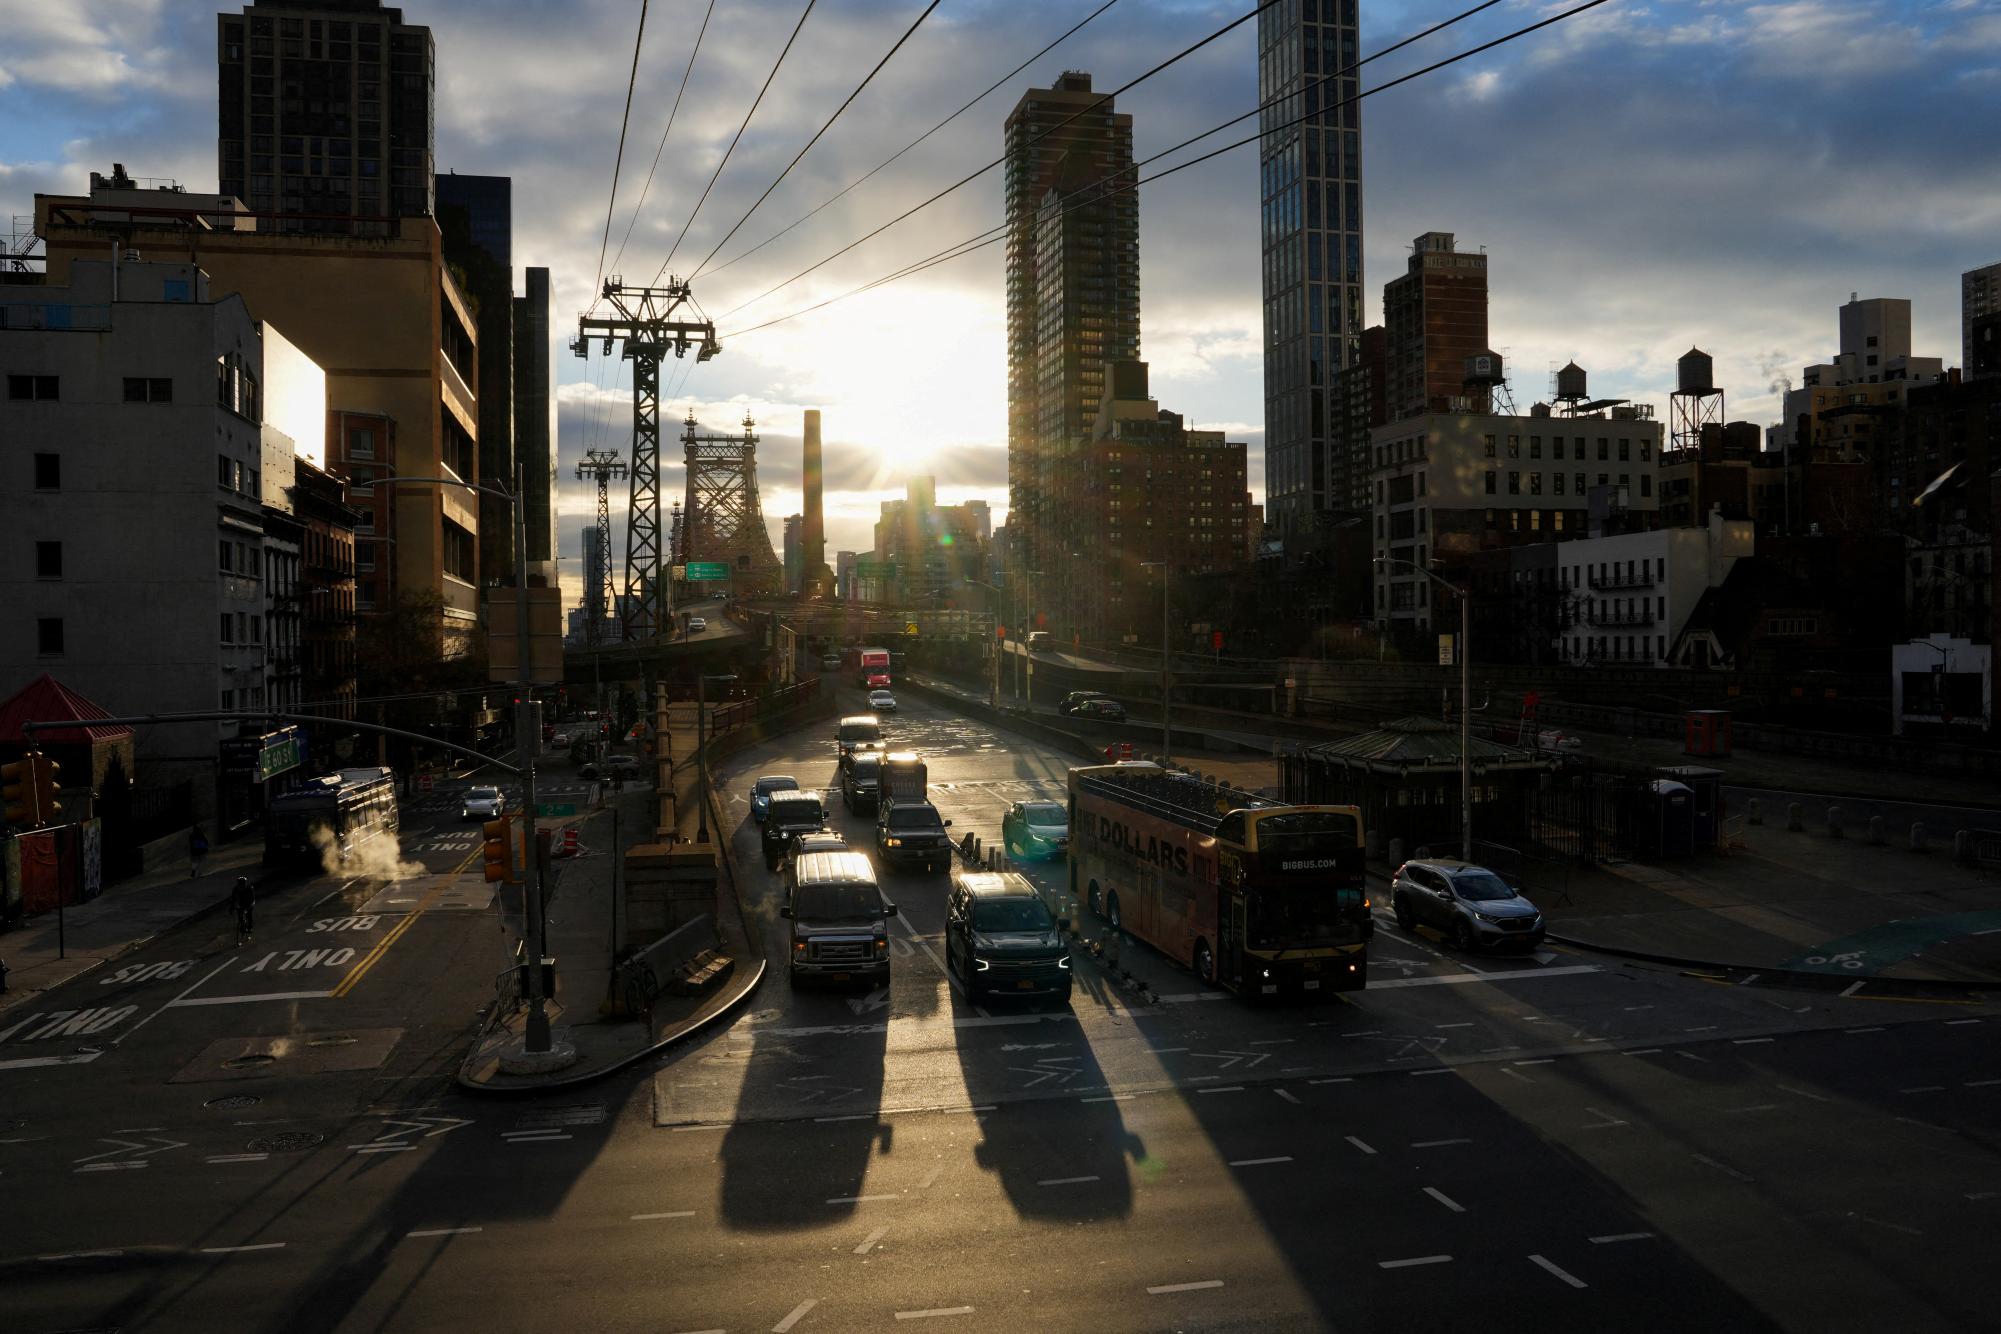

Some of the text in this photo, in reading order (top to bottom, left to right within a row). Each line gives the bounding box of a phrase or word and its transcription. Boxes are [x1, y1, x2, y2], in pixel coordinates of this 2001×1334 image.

[273, 750, 282, 768] 60
[432, 831, 478, 840] BUS
[409, 842, 471, 852] ONLY
[1100, 816, 1188, 876] DOLLARS
[1281, 858, 1337, 871] BIGBUS.COM
[305, 914, 382, 933] BUS
[239, 947, 356, 973] ONLY
[99, 959, 196, 985] BUS
